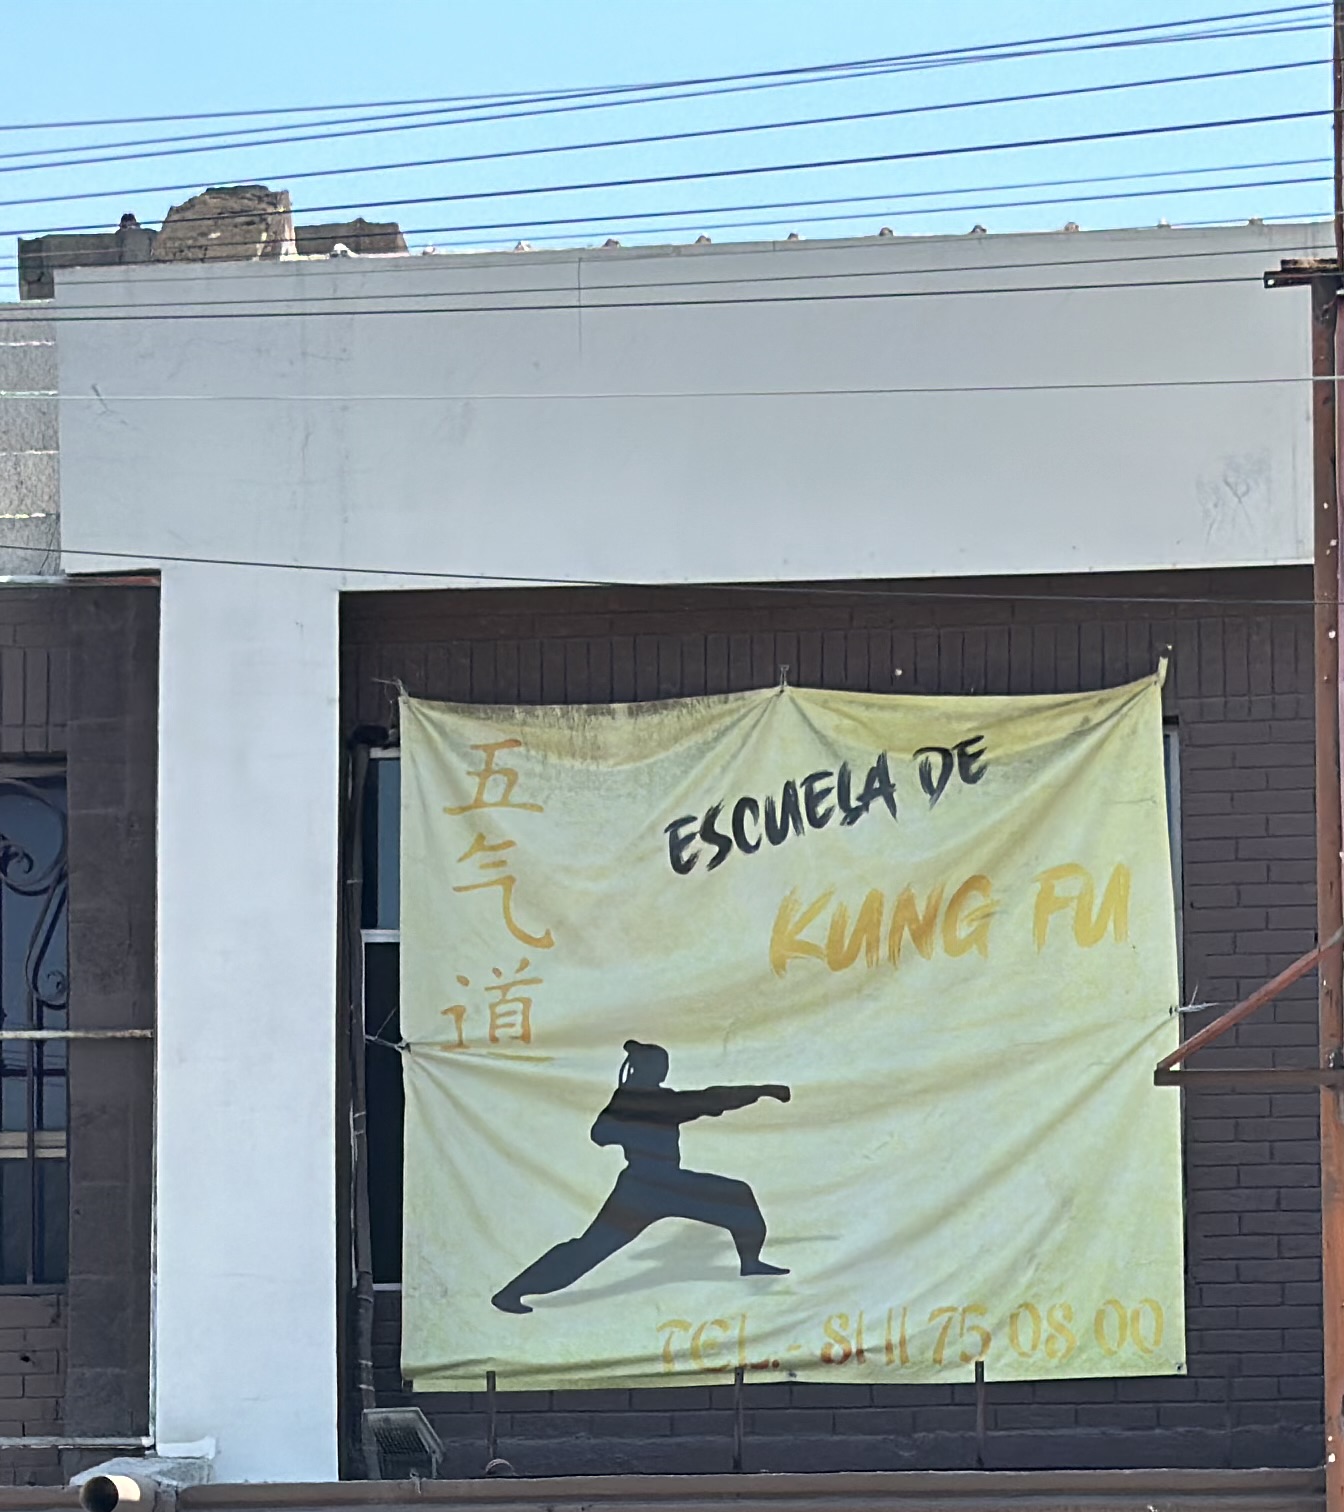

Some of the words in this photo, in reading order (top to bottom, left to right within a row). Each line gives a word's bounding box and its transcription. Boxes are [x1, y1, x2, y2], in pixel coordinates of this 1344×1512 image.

[664, 750, 898, 875] ESCUELA
[913, 735, 988, 810] DE
[440, 738, 555, 1063] 五气道
[769, 874, 1000, 978] KUNG
[1031, 863, 1132, 955] FU
